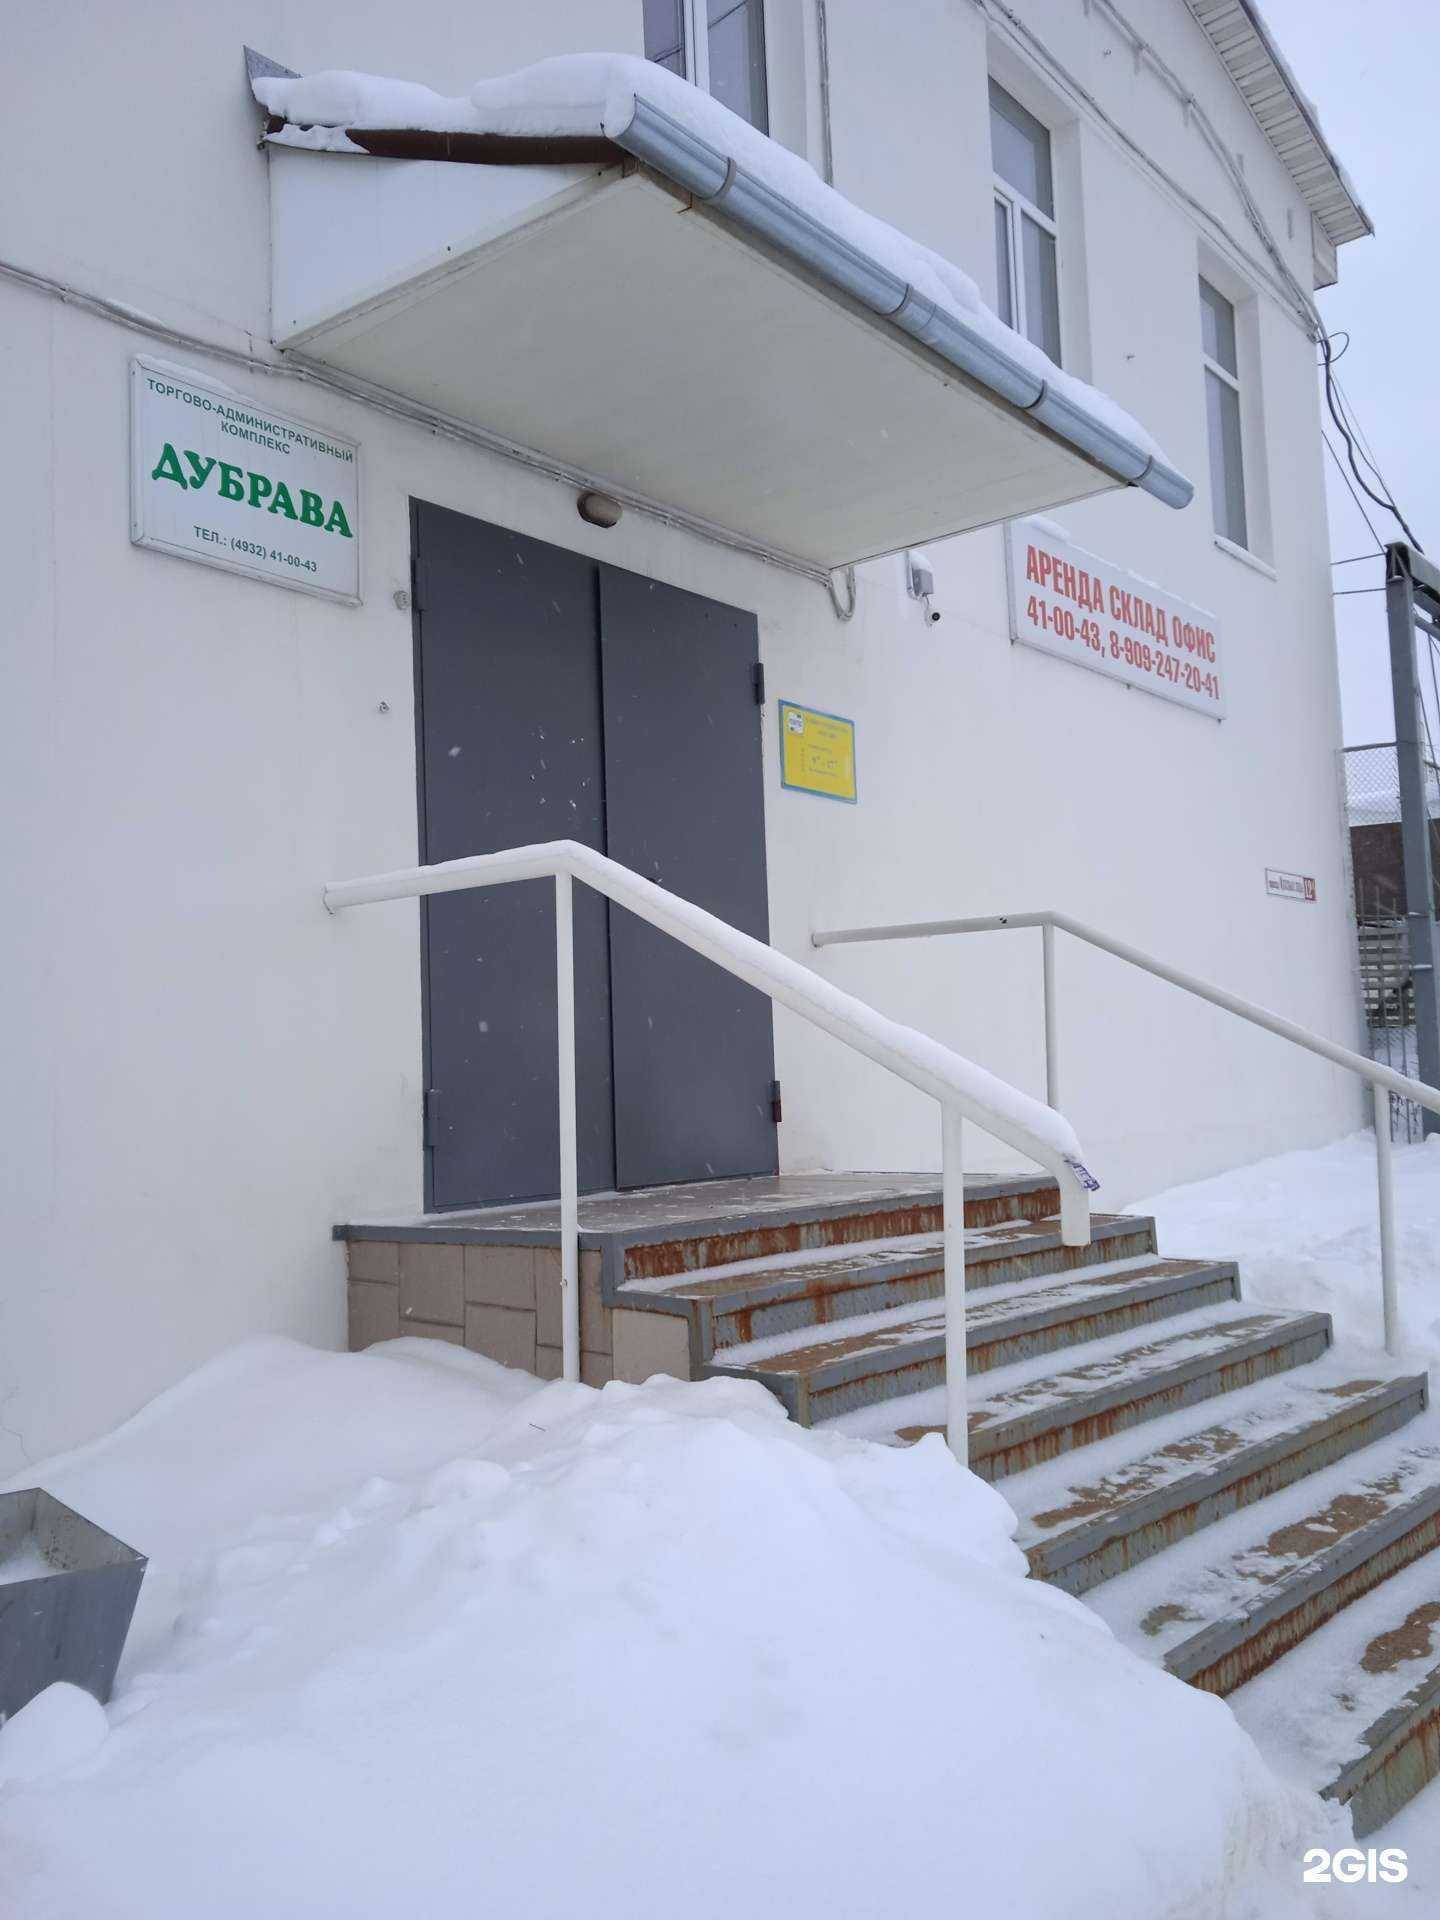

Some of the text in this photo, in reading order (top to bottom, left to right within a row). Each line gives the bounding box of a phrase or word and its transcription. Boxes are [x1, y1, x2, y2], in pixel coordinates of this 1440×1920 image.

[146, 378, 353, 463] ТОРГОВО-АДМИНИСТРАТИВНЫЙ
[220, 420, 291, 455] КОМПЛЕКС
[151, 442, 353, 538] ДУБРАВА
[193, 525, 318, 573] ТЕЛ.: (4932) 41-00-43
[1026, 544, 1216, 663] АРЕНДА СКЛАД ОФИС
[1026, 595, 1220, 700] 41-00-43, 8-909-247-20-41
